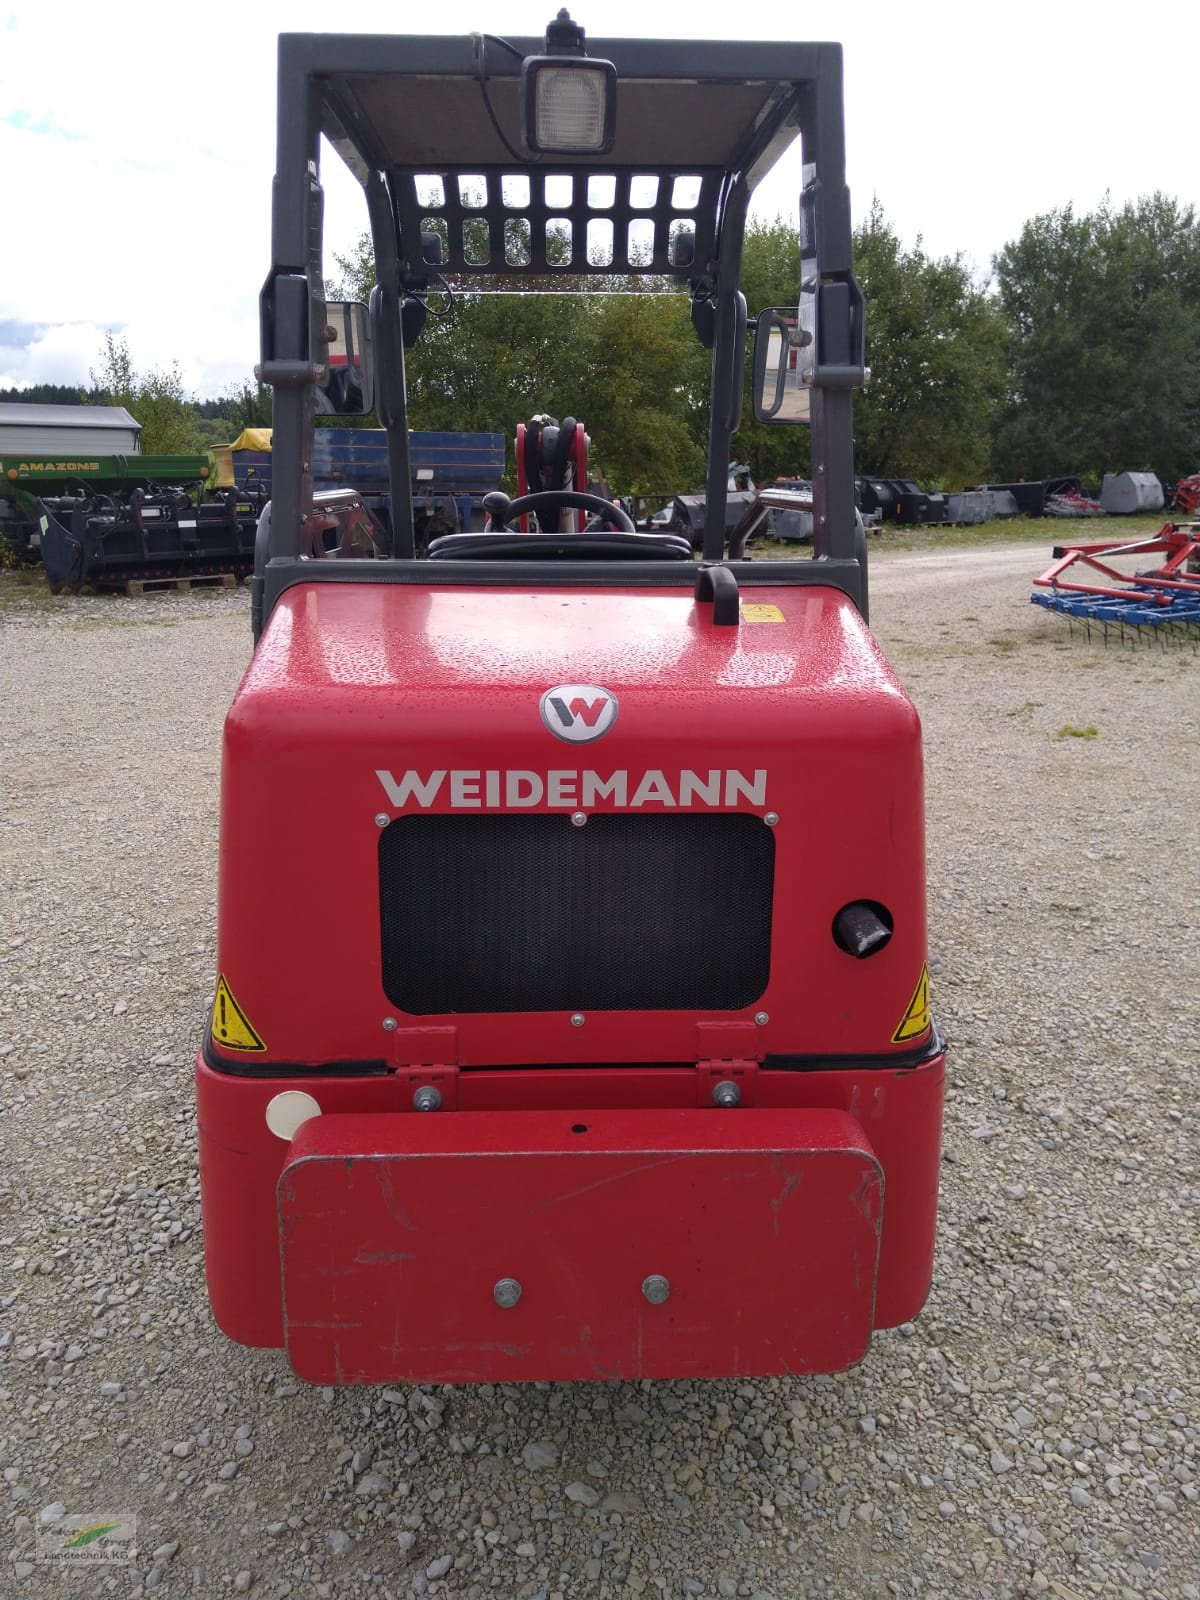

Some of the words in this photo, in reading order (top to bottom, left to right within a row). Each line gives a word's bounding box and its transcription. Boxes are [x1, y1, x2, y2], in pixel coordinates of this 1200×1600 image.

[19, 462, 99, 471] AMAZONE
[548, 697, 610, 727] W
[375, 769, 767, 808] WEIDEMANN
